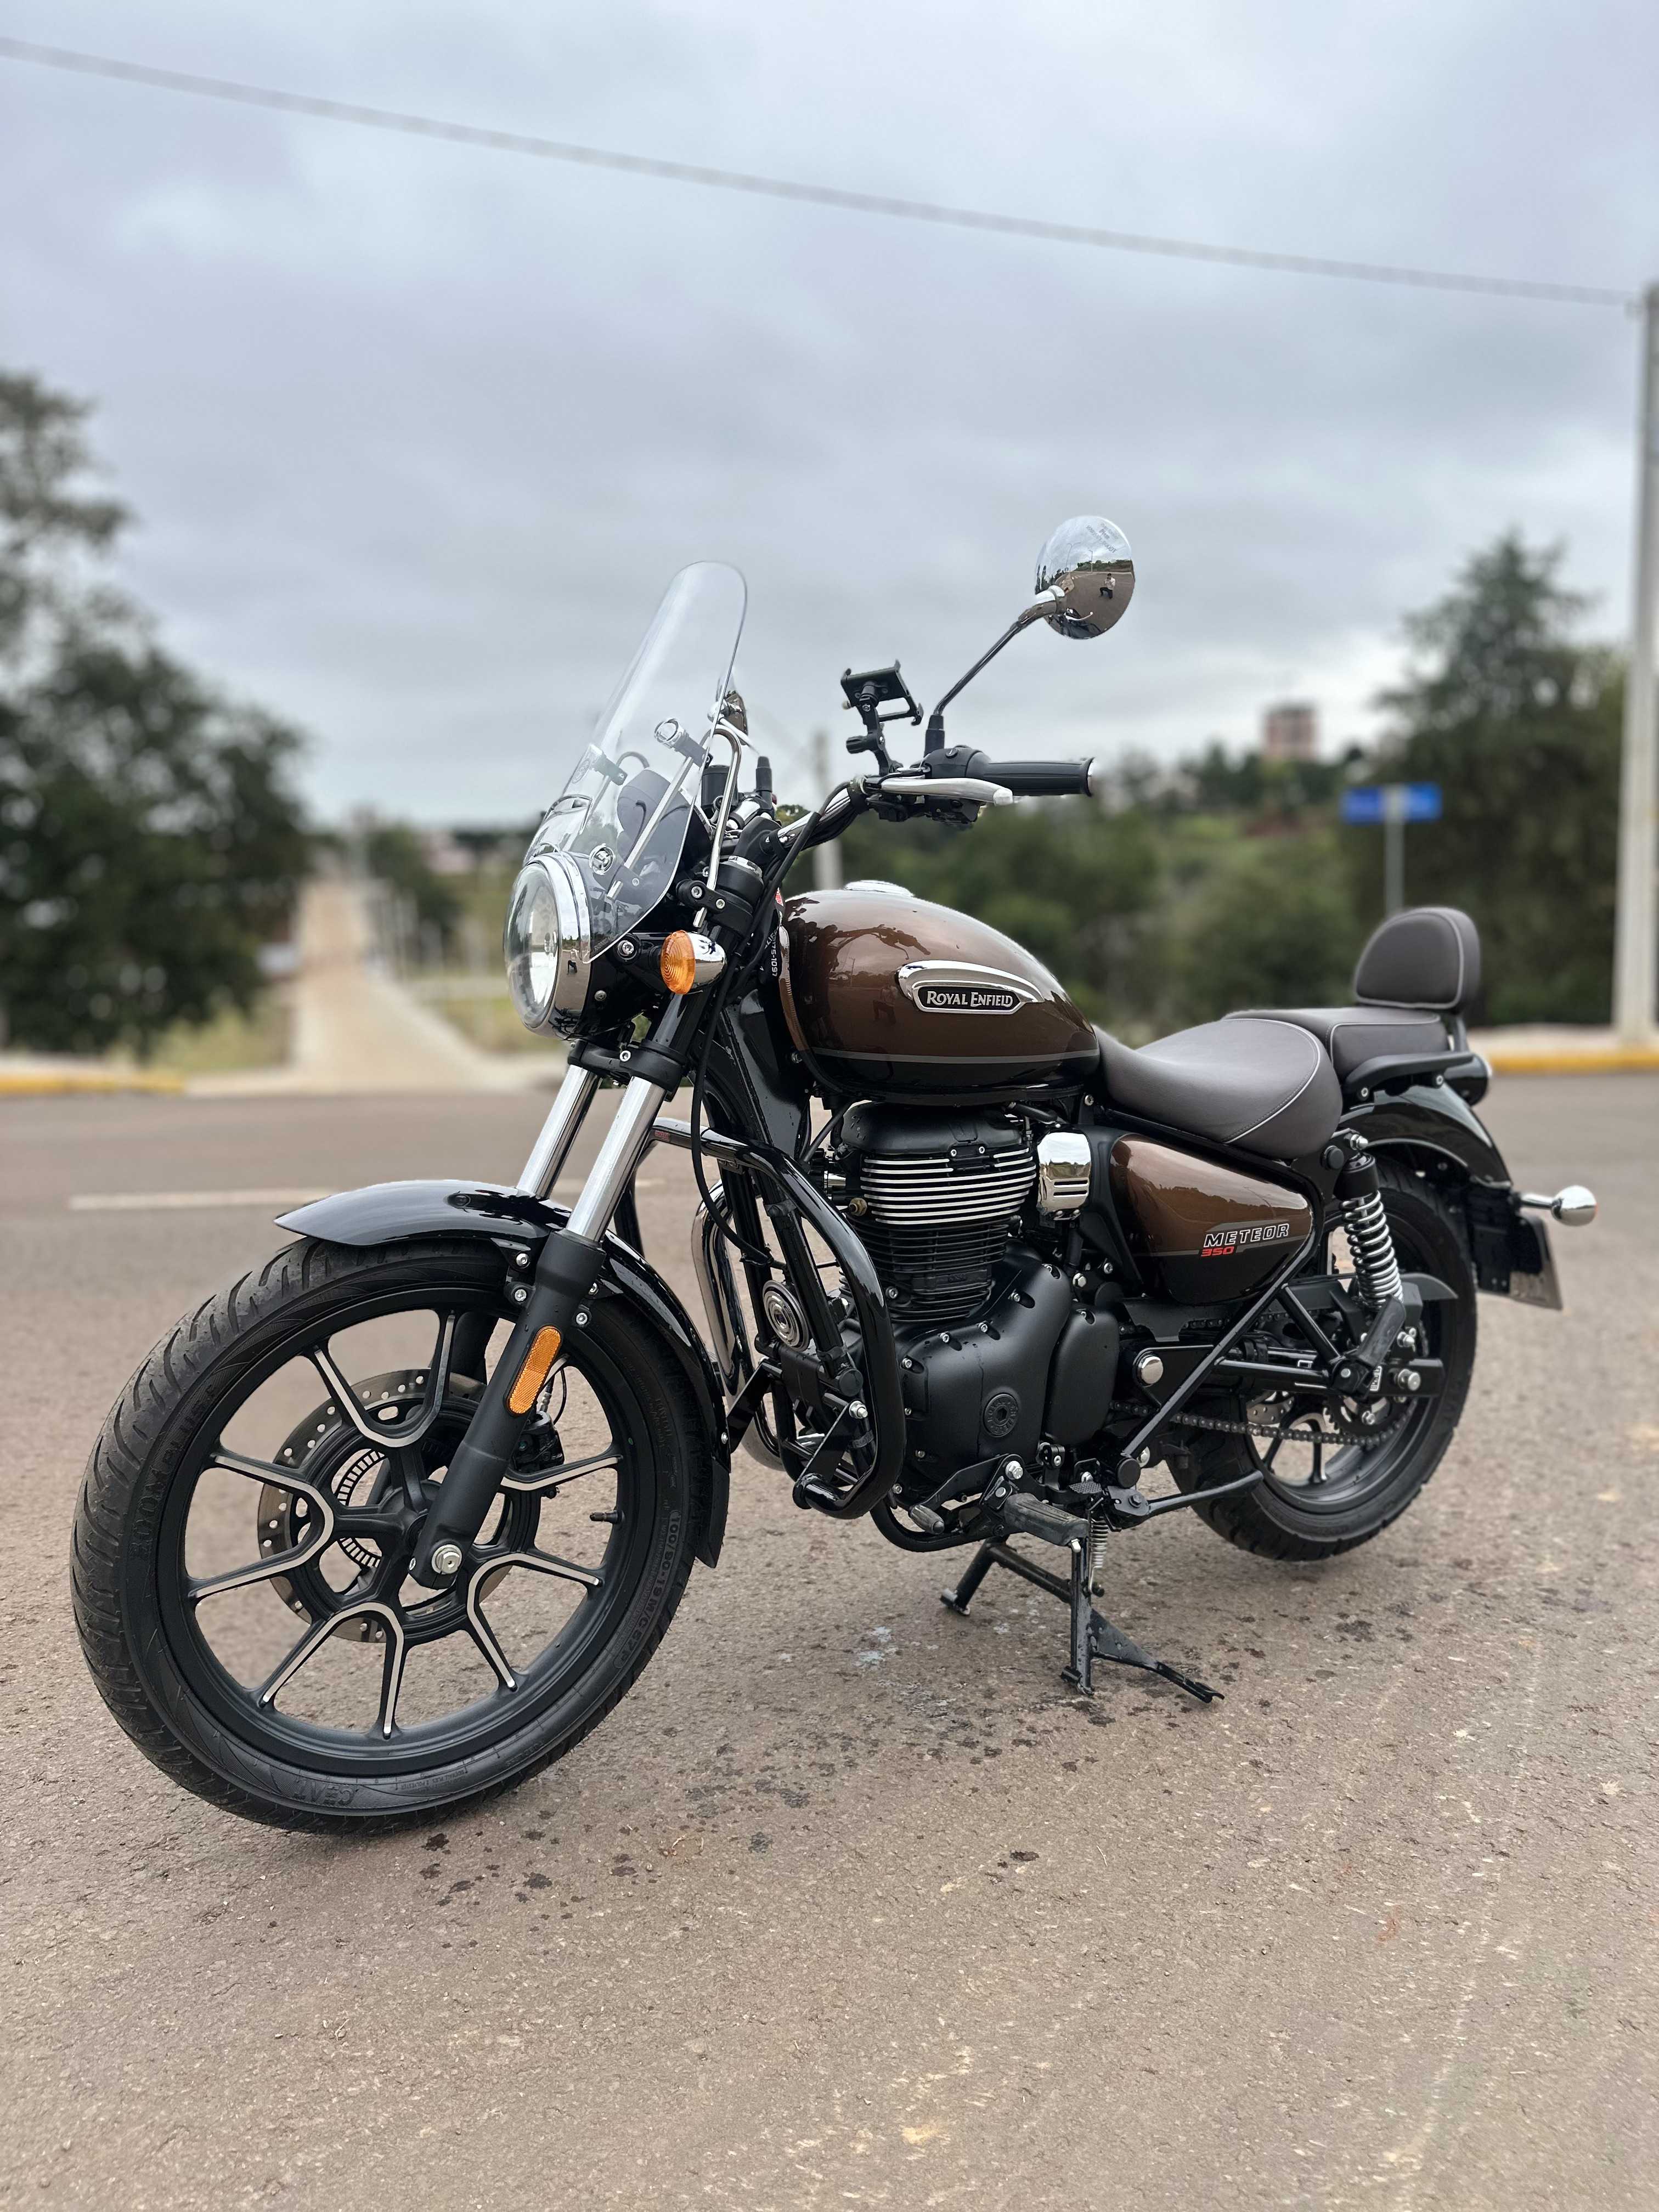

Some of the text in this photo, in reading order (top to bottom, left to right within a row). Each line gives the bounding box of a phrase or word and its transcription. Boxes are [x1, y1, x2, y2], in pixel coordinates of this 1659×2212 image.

[927, 991, 1013, 1007] ROYAL ENFIELD
[1203, 1223, 1289, 1248] METEOR
[1201, 1246, 1234, 1257] 350
